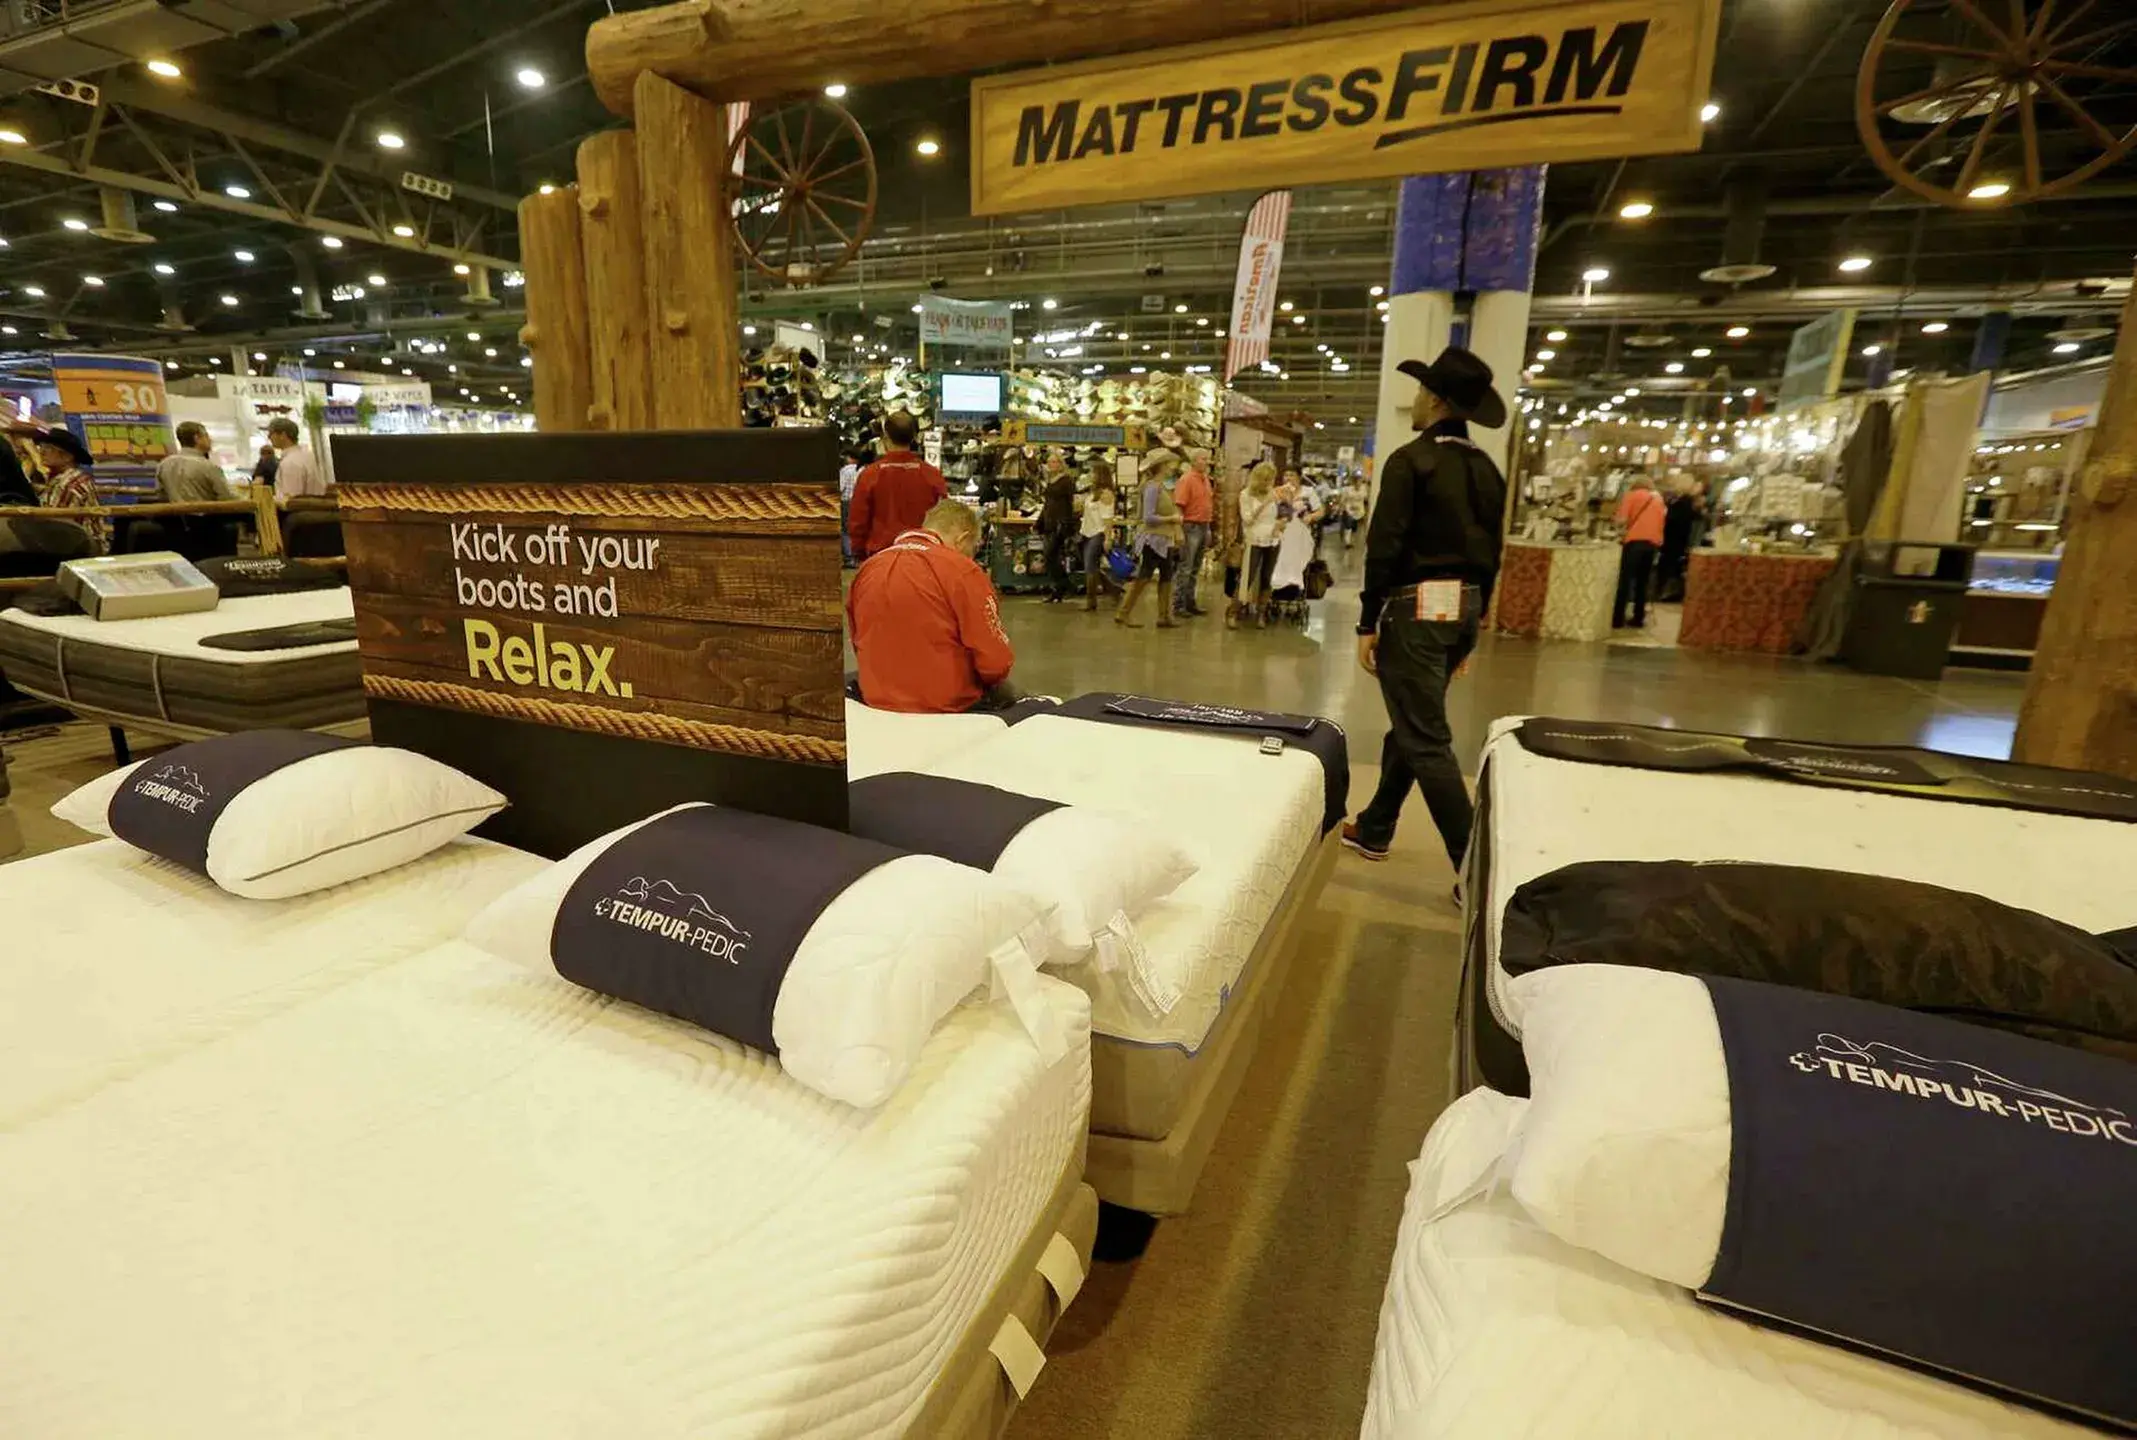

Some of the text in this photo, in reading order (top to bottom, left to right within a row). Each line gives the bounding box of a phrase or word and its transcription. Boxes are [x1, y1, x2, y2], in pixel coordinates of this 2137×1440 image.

[113, 382, 158, 413] 30
[450, 523, 660, 575] Kick off your
[456, 568, 619, 617] boots and
[464, 618, 634, 699] Relax.
[140, 780, 204, 814] TEMPUR-PEDIC
[609, 900, 746, 965] TEMPUR-PEDIC
[1819, 1056, 2137, 1146] TEMPUR-PEDIC
